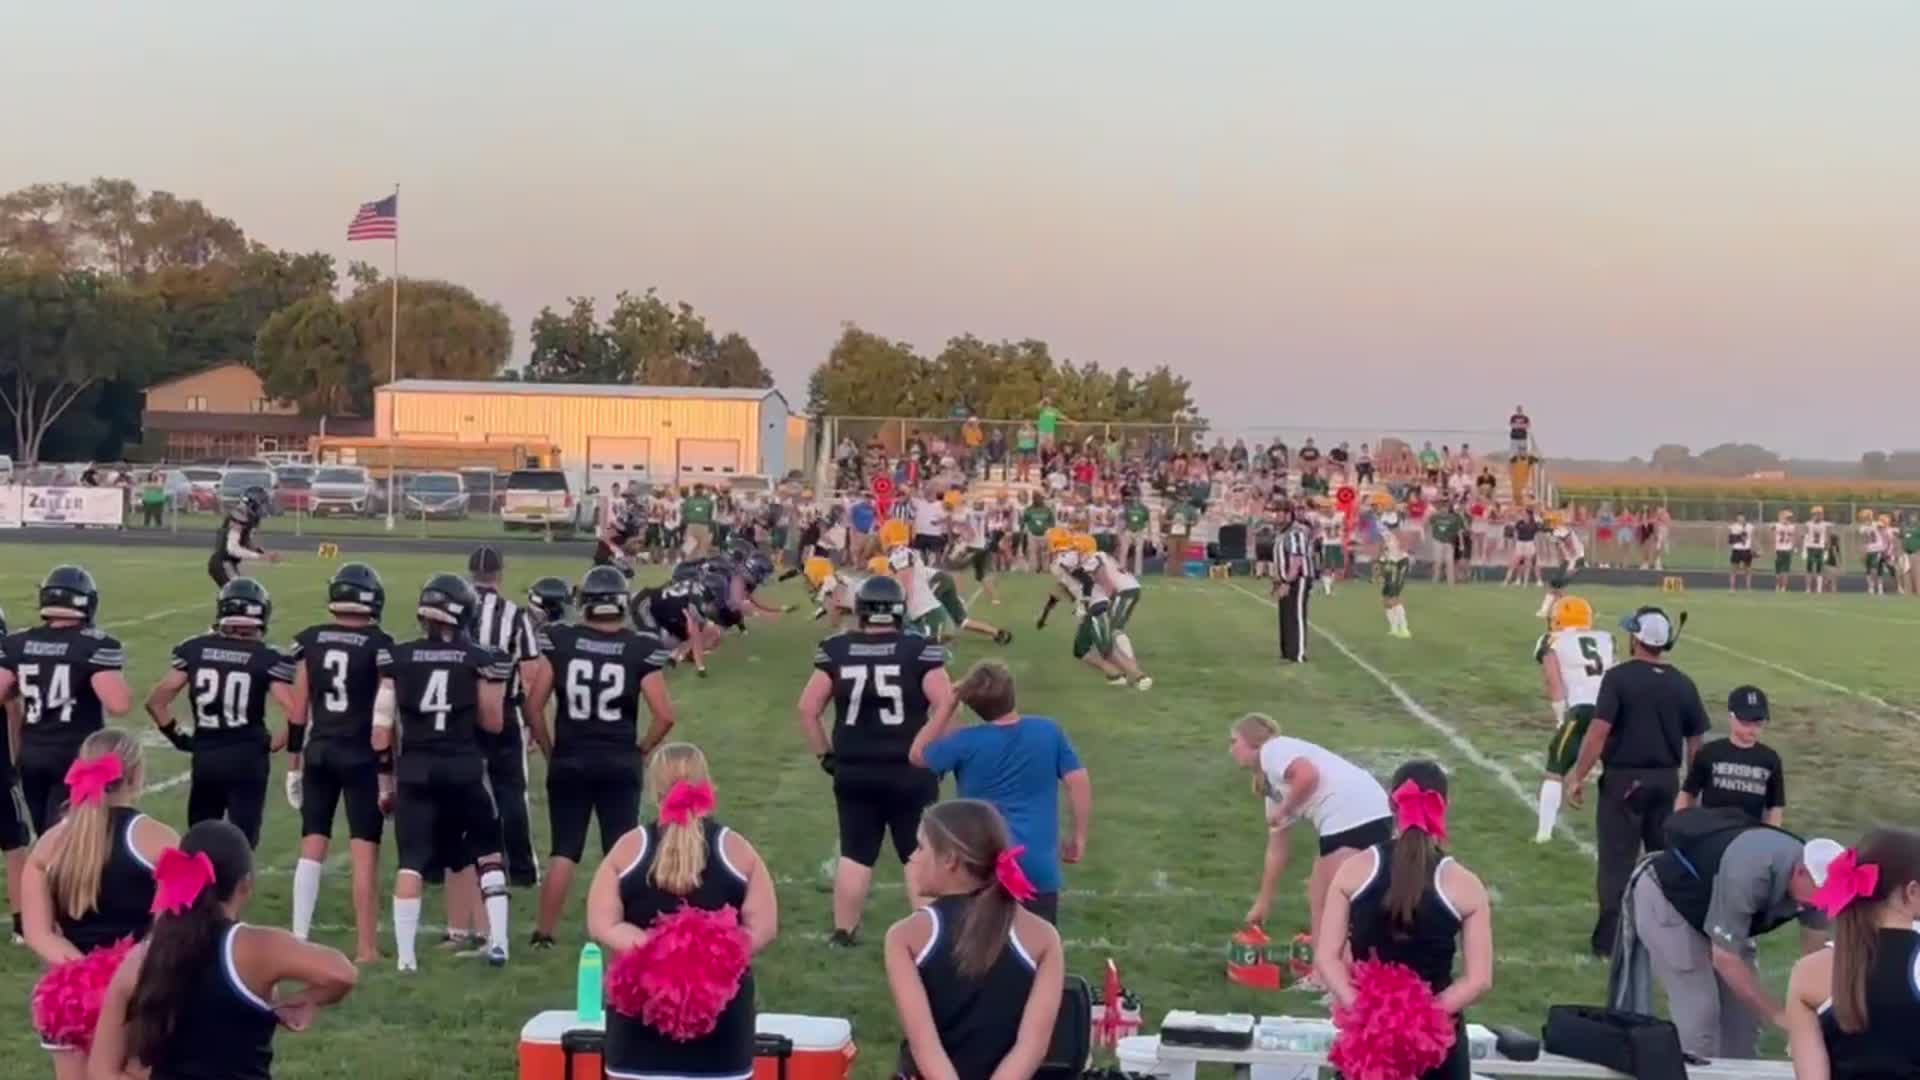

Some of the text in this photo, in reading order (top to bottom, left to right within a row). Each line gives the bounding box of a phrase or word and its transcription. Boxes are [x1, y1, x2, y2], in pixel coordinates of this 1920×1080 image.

[323, 650, 349, 712] 3
[1578, 636, 1603, 677] 5
[17, 663, 76, 724] 54
[195, 668, 251, 728] 20
[420, 669, 452, 731] 4
[566, 658, 625, 721] 62
[840, 664, 904, 726] 75
